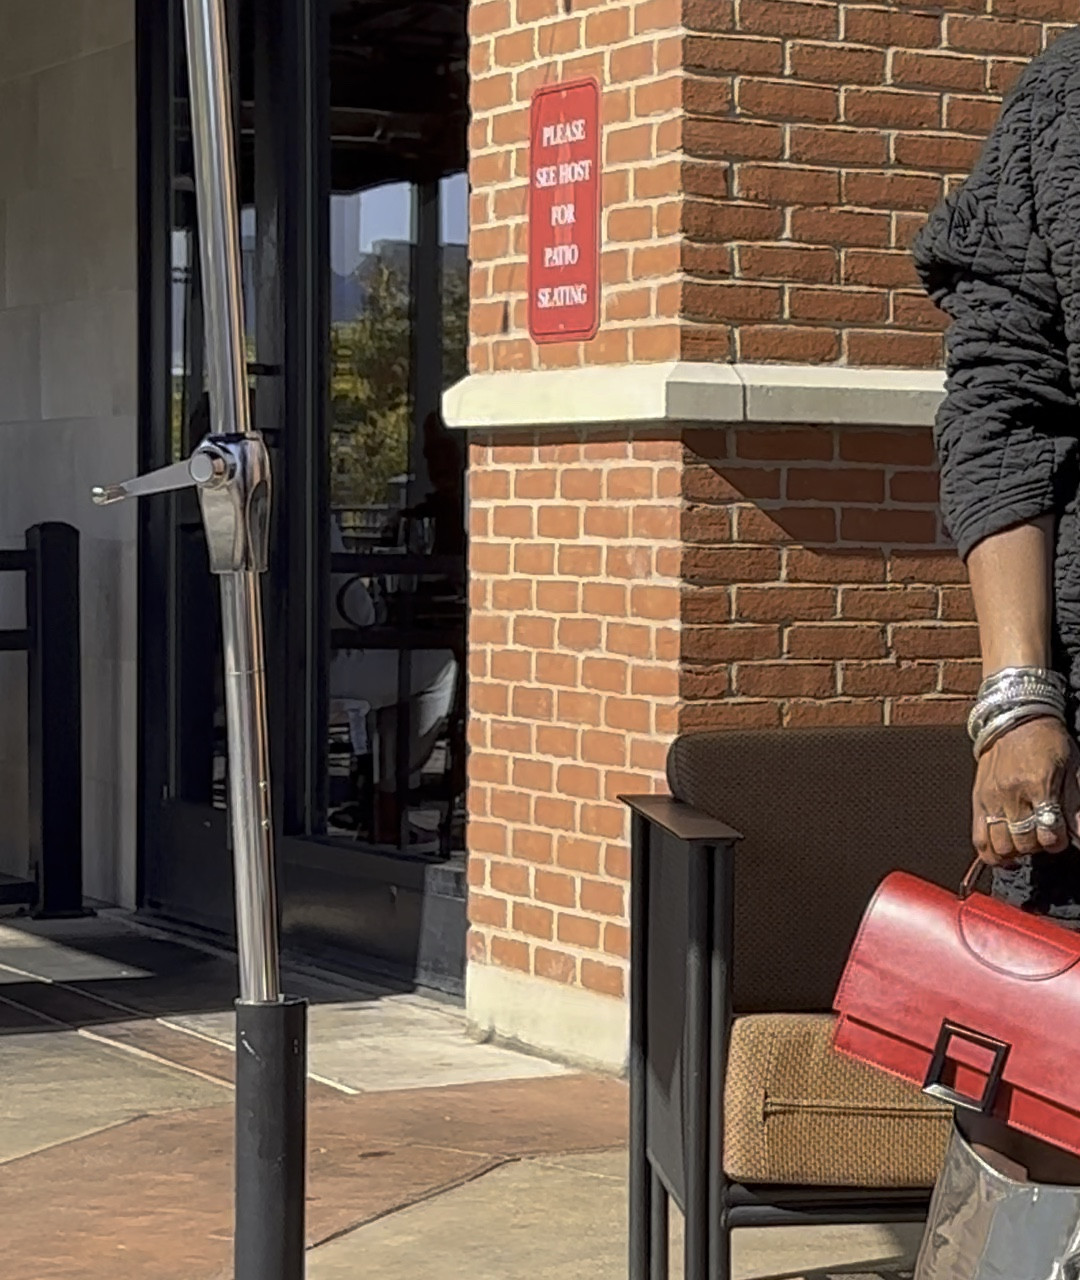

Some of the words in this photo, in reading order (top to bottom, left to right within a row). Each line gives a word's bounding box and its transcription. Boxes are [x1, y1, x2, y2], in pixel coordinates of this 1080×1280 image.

[542, 119, 586, 148] PLEASE
[535, 165, 557, 189] SEE
[559, 159, 592, 185] HOST
[551, 203, 576, 227] FOR
[543, 244, 579, 268] PATIO
[537, 283, 588, 309] SEATING
